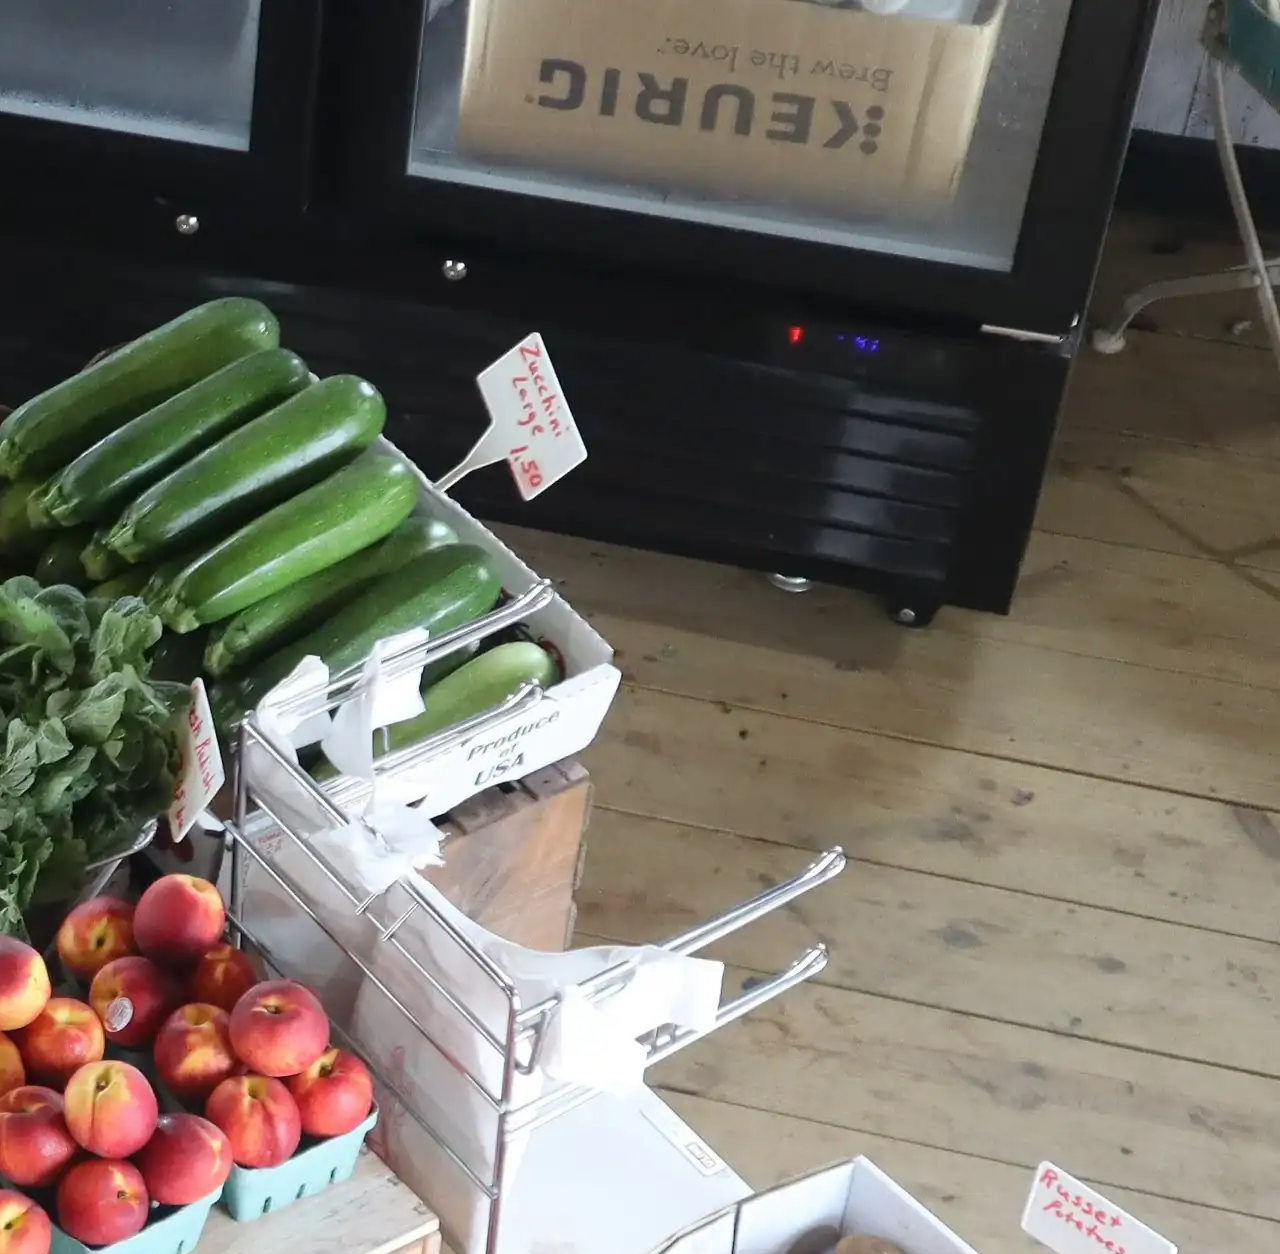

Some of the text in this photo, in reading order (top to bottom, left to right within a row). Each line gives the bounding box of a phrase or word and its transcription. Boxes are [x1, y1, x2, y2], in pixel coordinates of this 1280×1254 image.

[750, 49, 800, 80] the
[811, 58, 893, 92] Brew
[537, 57, 884, 156] KEURIG
[512, 376, 544, 436] Large
[520, 343, 570, 438] Zucchini
[509, 446, 543, 487] 1.50
[467, 711, 559, 761] Produce
[499, 741, 518, 758] of
[474, 752, 524, 786] USA
[1039, 1168, 1122, 1227] Russet
